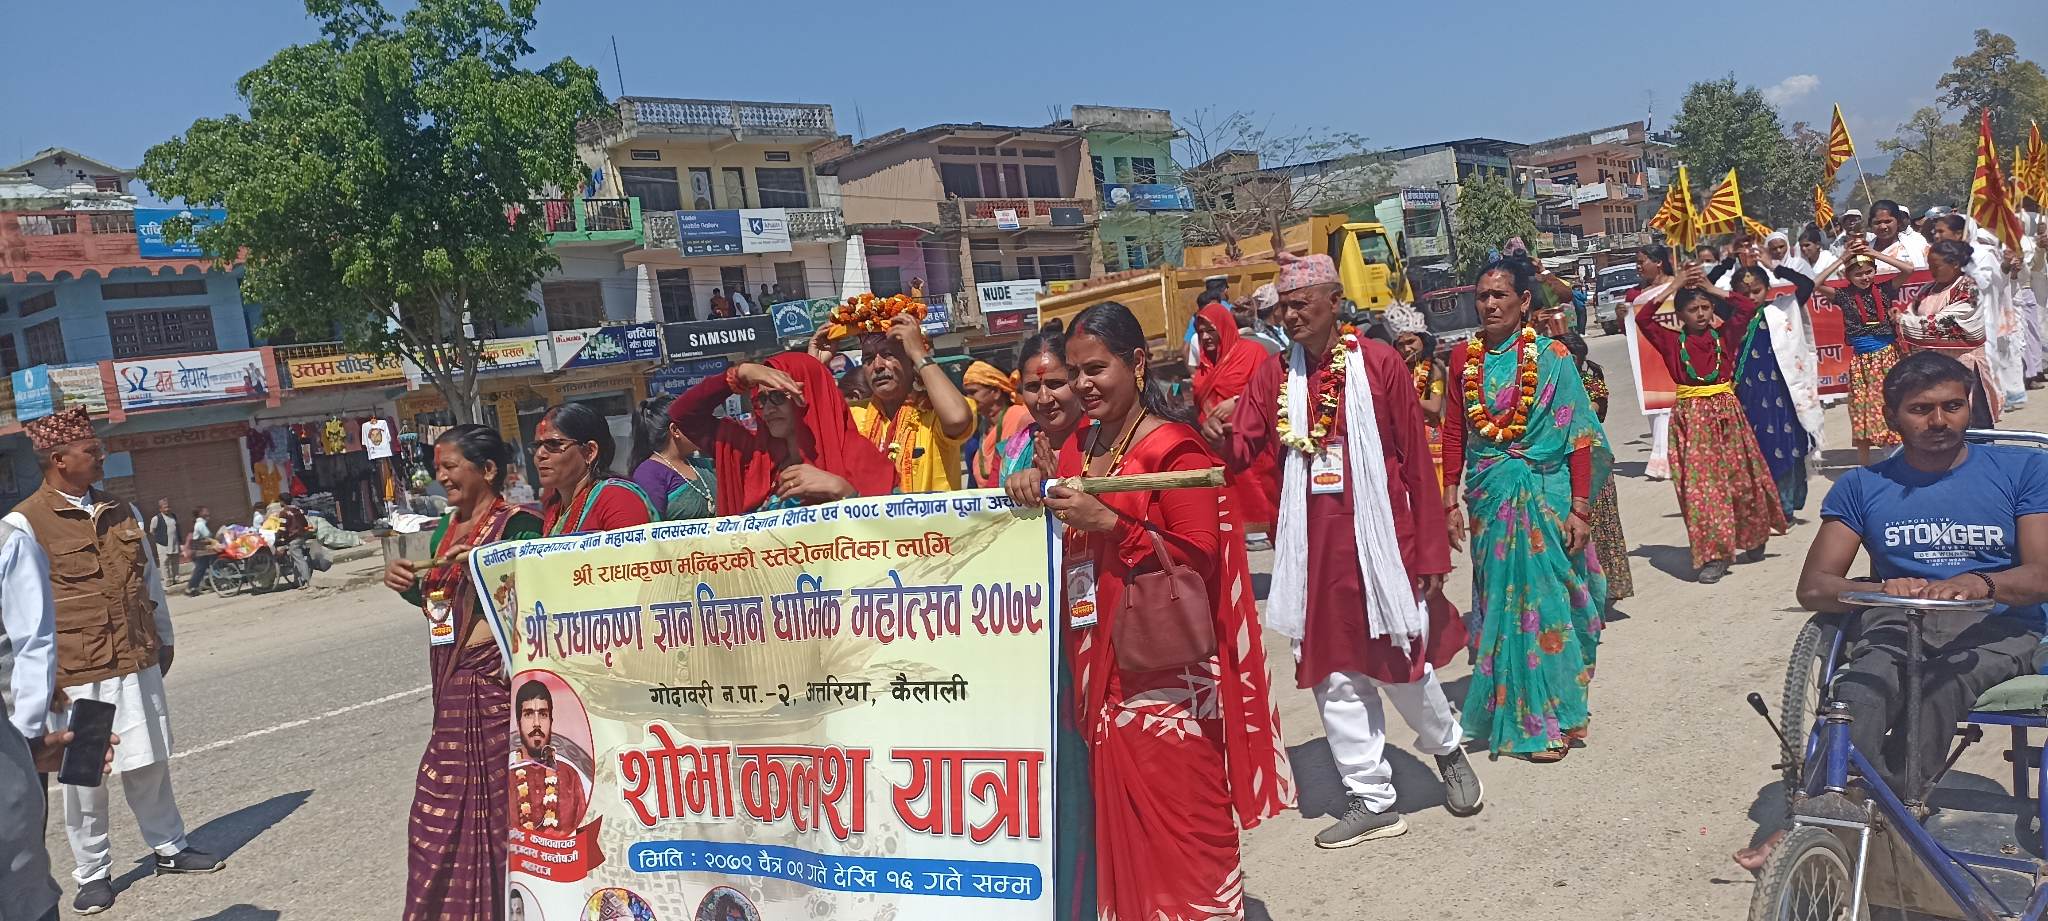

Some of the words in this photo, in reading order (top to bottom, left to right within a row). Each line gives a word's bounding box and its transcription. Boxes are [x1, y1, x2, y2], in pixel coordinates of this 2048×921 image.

[983, 286, 1012, 301] NUDE
[689, 327, 756, 348] SAMSUNG
[177, 360, 211, 390] नेपाल
[292, 361, 334, 379] उत्तम
[660, 366, 685, 375] vivo
[699, 361, 722, 370] vivo
[580, 535, 601, 551] ज्ञान
[743, 513, 778, 533] विज्ञान
[781, 503, 817, 528] शिविर
[821, 501, 840, 522] एवं
[844, 504, 880, 520] १००८
[886, 494, 948, 518] शालिग्राम
[953, 496, 983, 519] पूजा
[1884, 521, 2005, 547] STONGER
[1907, 516, 1951, 524] POSITIVE
[573, 564, 596, 588] श्री
[598, 556, 675, 584] राधाकृष्ण
[677, 543, 760, 576] मन्दिरको
[761, 534, 891, 570] स्तरोन्नतिका
[895, 532, 953, 561] लागि
[526, 600, 550, 662] श्री
[554, 606, 645, 668] राधाकृष्ण
[653, 598, 694, 654] ज्ञान
[696, 582, 765, 650] विज्ञान
[769, 572, 842, 641] धार्मिक
[851, 566, 963, 645] महोत्सव
[971, 581, 1044, 637] २०७९
[649, 680, 715, 708] गोदावरी
[890, 671, 970, 702] कैलाली
[619, 717, 736, 828] शोभा
[735, 743, 871, 842] कलश
[891, 745, 1046, 843] यात्रा
[637, 846, 685, 873] मिति
[703, 852, 755, 875] २०७९
[758, 848, 784, 877] चैत्र
[806, 858, 829, 888] गते
[832, 861, 877, 890] देखि
[886, 869, 915, 890] १६
[922, 866, 964, 893] गते
[973, 873, 1033, 896] सम्म
